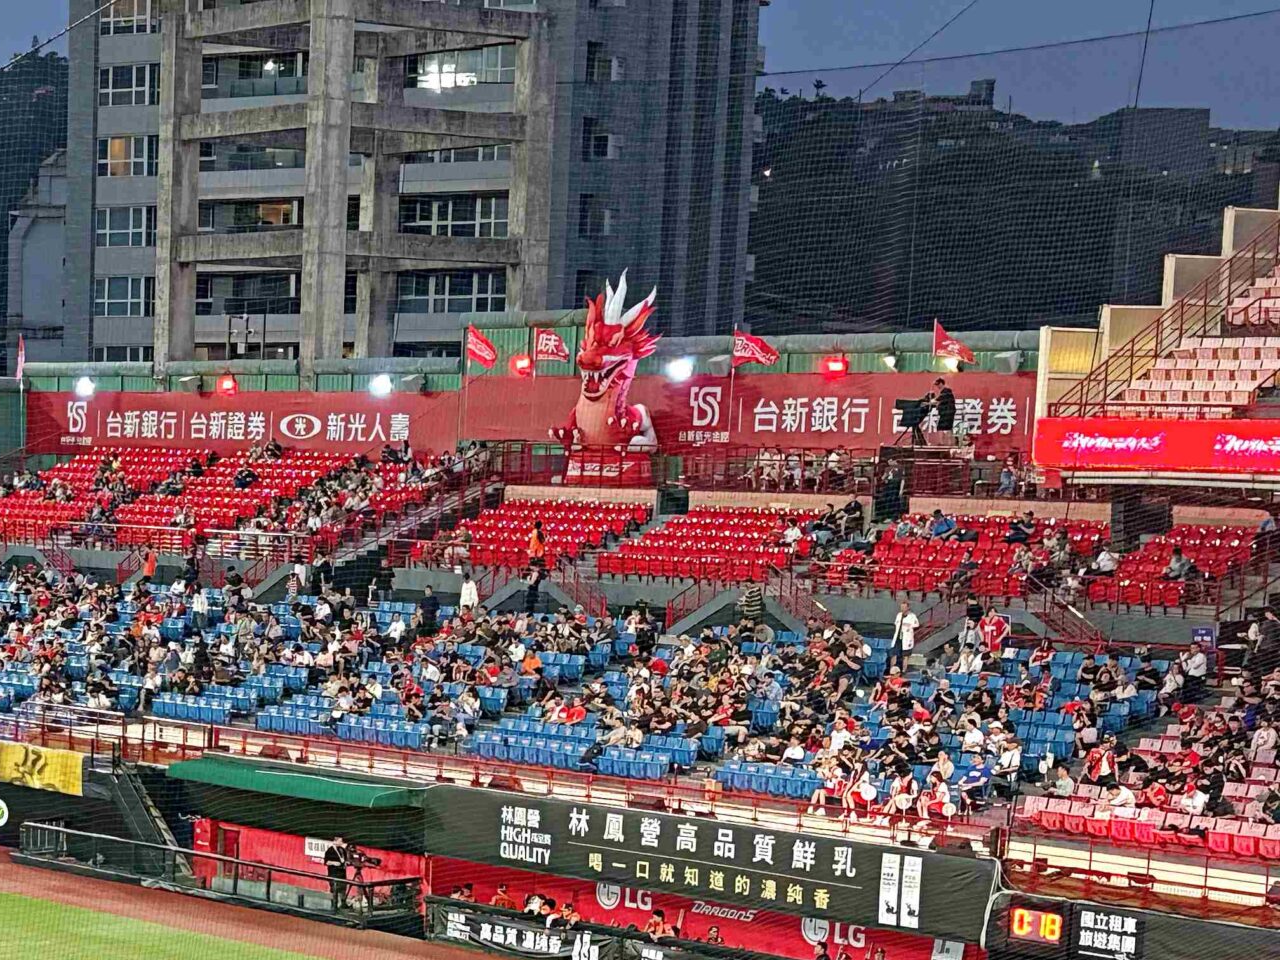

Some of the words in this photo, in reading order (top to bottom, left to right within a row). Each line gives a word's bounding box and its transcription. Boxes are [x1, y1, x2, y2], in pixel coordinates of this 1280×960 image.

[106, 410, 177, 439] 台新銀行
[190, 411, 266, 440] 台新證券
[326, 412, 411, 442] 新光人壽
[753, 397, 870, 433] 台新銀行
[500, 825, 531, 846] HIGH
[568, 807, 857, 878] 林鳳營高品質鮮乳
[500, 842, 551, 866] QUALITY
[588, 852, 831, 910] 喝一口就知道的濃純香
[624, 887, 652, 911] LG
[833, 922, 866, 948] LG
